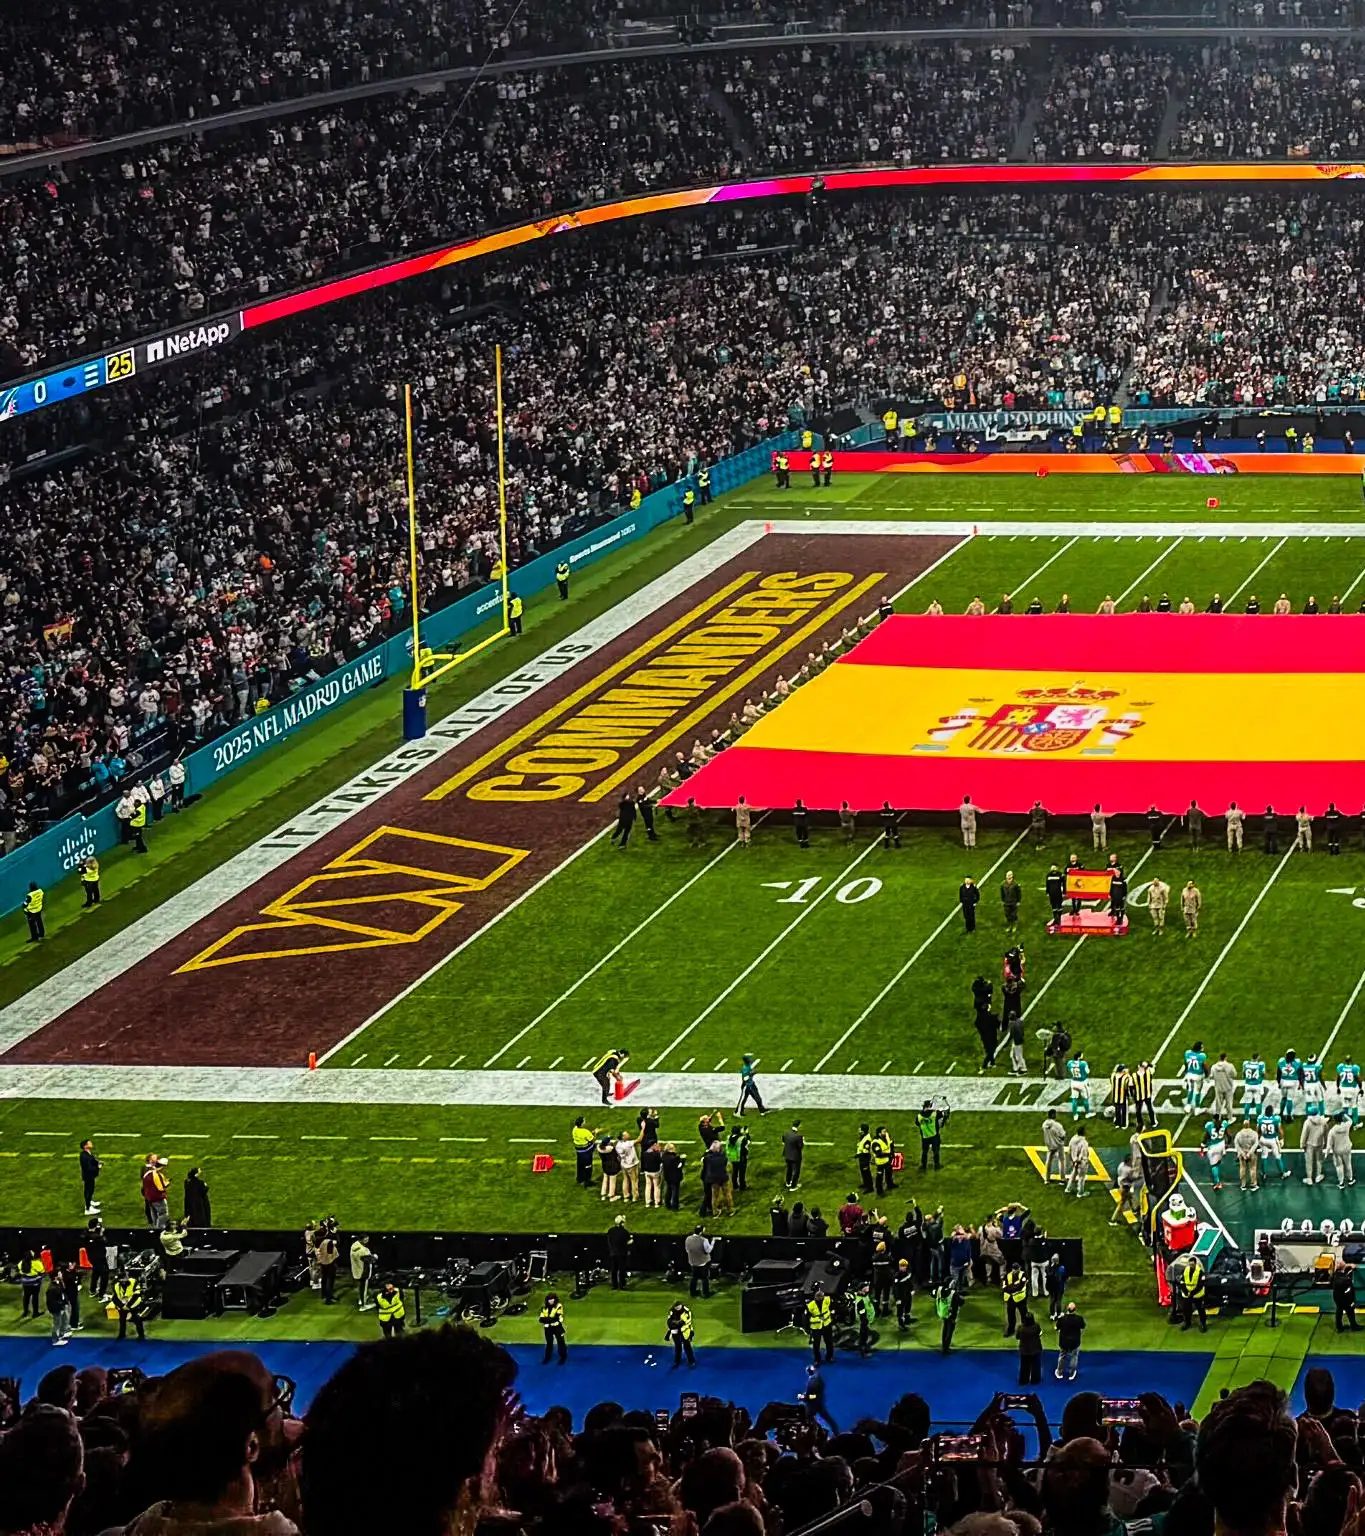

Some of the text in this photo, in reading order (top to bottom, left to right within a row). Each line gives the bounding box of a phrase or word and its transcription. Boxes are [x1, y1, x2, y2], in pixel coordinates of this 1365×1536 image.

[166, 321, 230, 357] NetApp
[108, 352, 132, 379] 25
[33, 380, 47, 404] 0
[466, 571, 855, 803] COMMANDERS
[213, 654, 382, 772] 2025 NFL MADRID GAME
[260, 643, 594, 850] IT TAKES ALL OF US
[774, 875, 885, 905] 10
